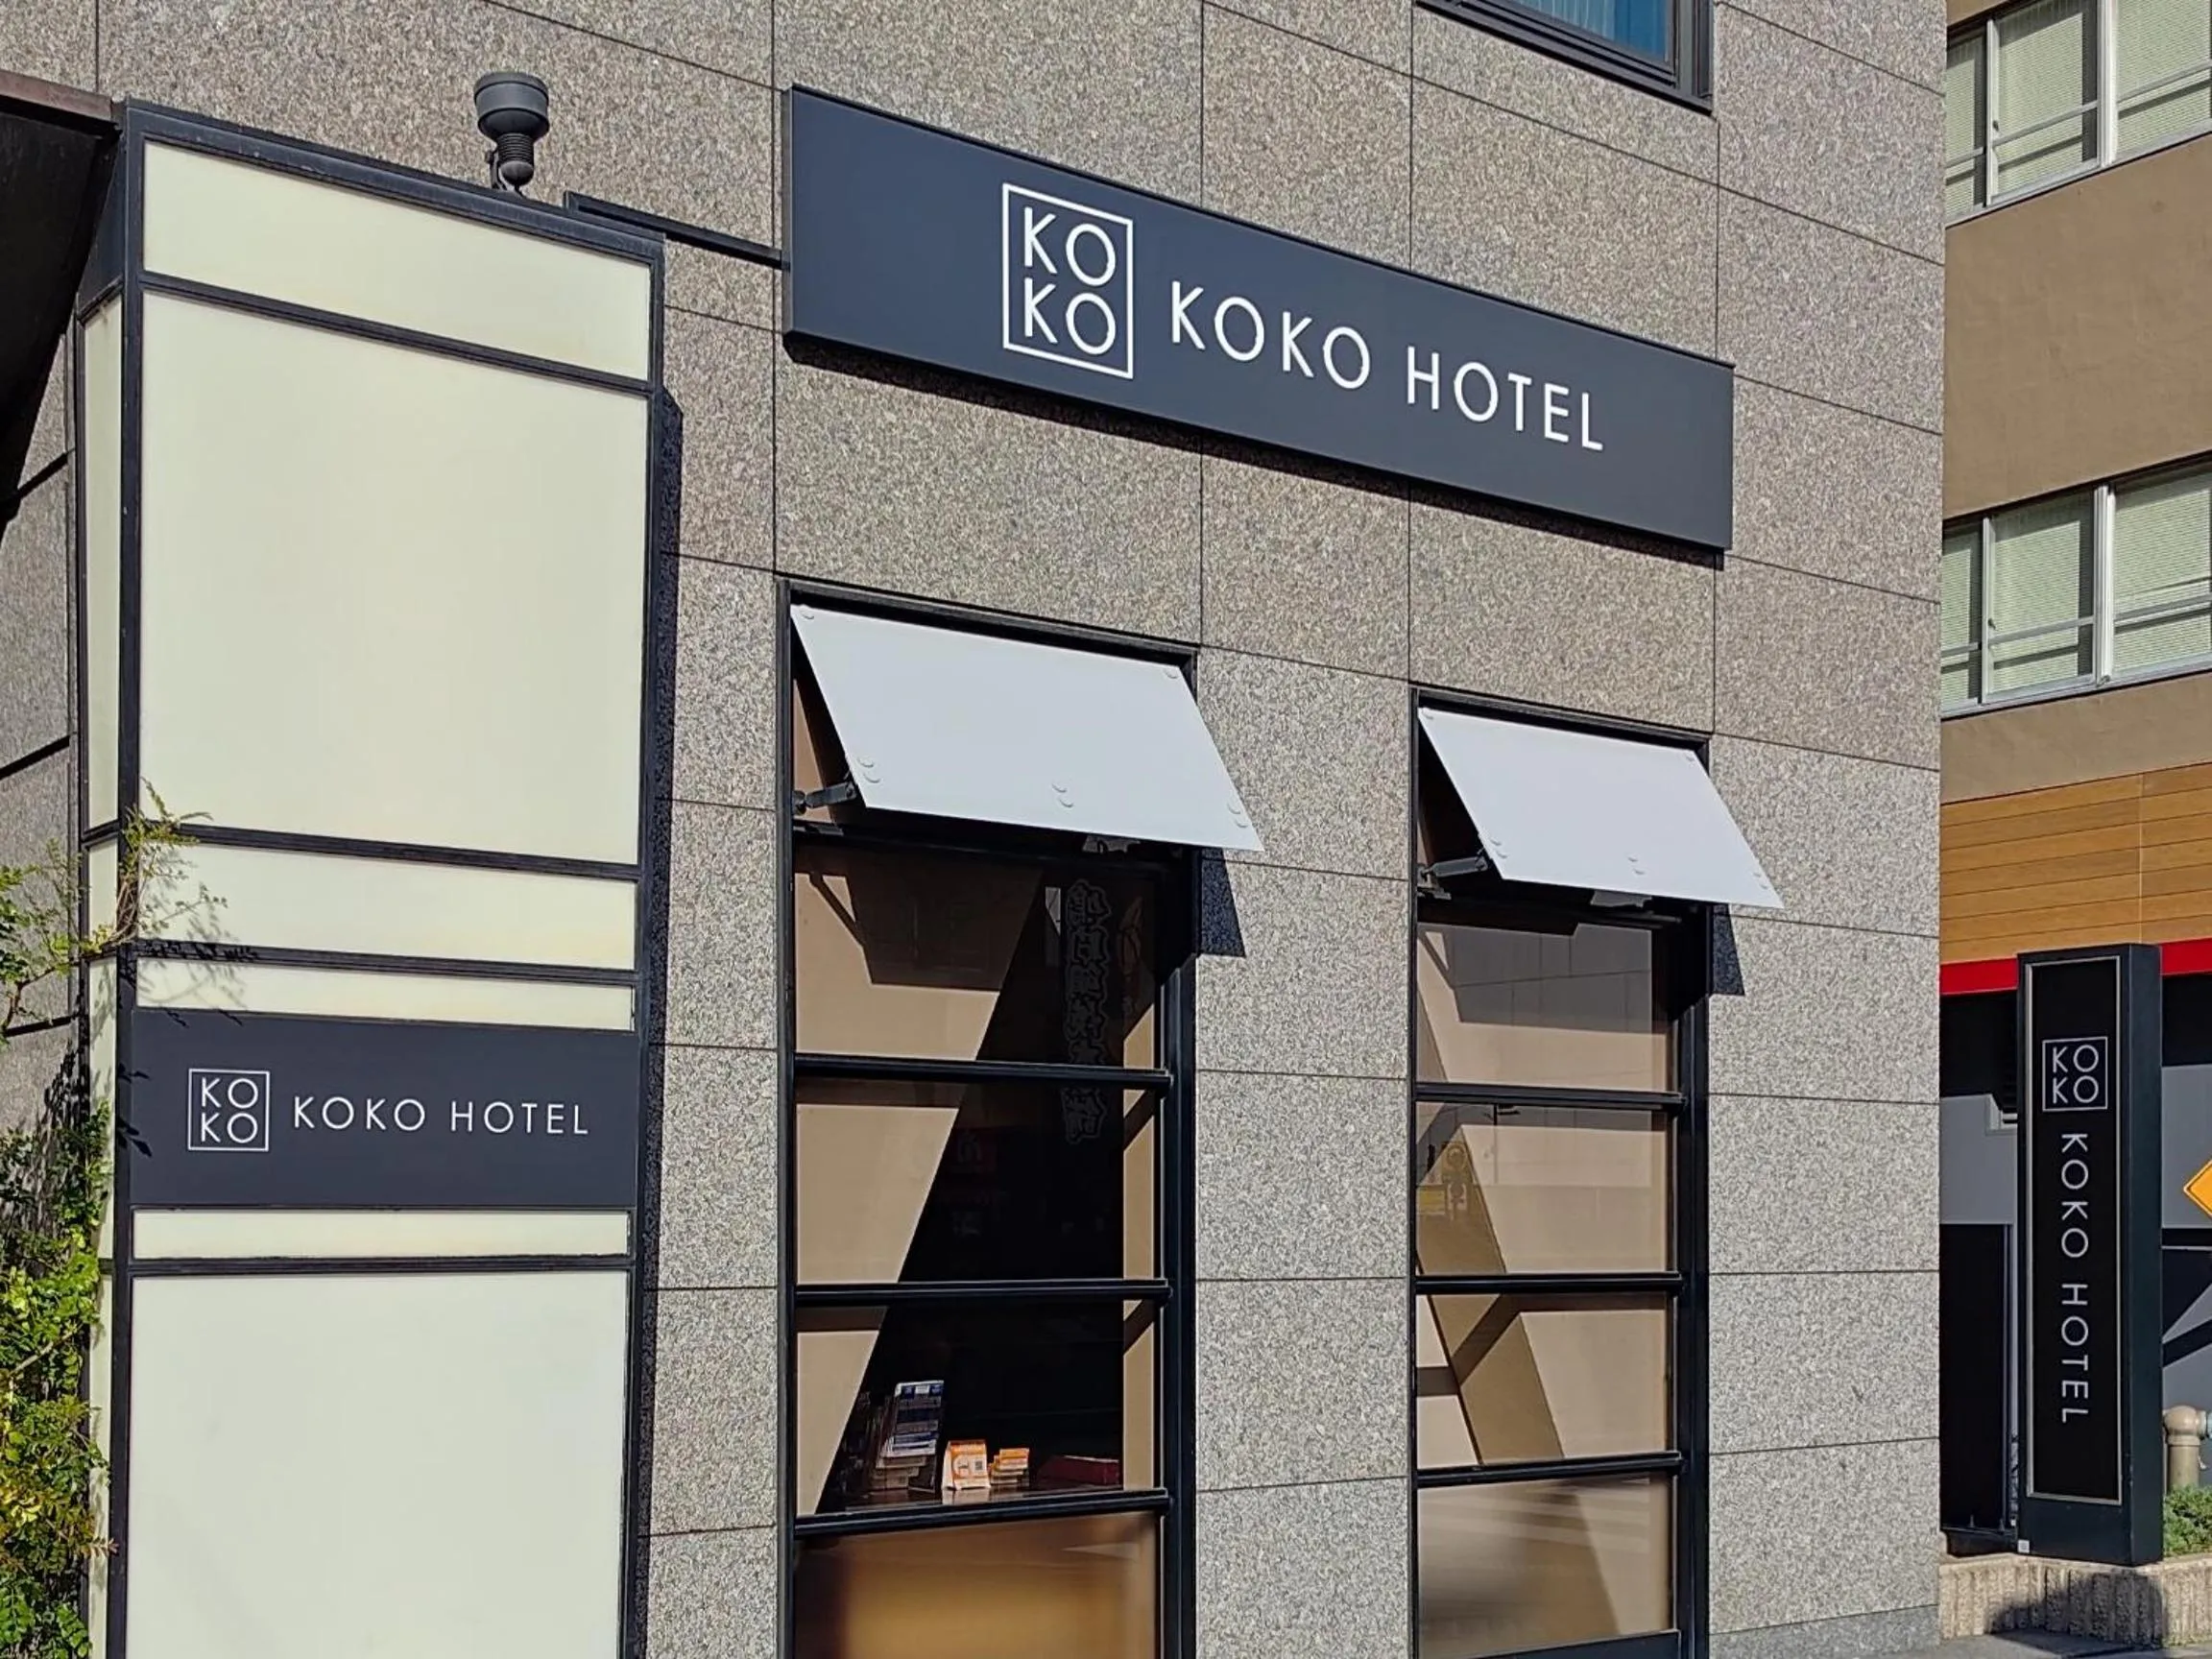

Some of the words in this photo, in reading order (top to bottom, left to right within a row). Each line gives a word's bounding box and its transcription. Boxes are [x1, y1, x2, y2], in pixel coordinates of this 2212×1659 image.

[1023, 206, 1117, 286] KO
[1023, 276, 1117, 355] KO
[1171, 280, 1370, 389] KOKO
[1407, 346, 1603, 451] HOTEL
[2052, 1044, 2100, 1073] KO
[201, 1076, 259, 1110] KO
[294, 1095, 425, 1131] KOKO
[450, 1100, 589, 1135] HOTEL
[2052, 1074, 2100, 1104] KO
[201, 1112, 259, 1144] KO
[2060, 1132, 2089, 1259] KOKO
[2060, 1283, 2089, 1423] HOTEL
